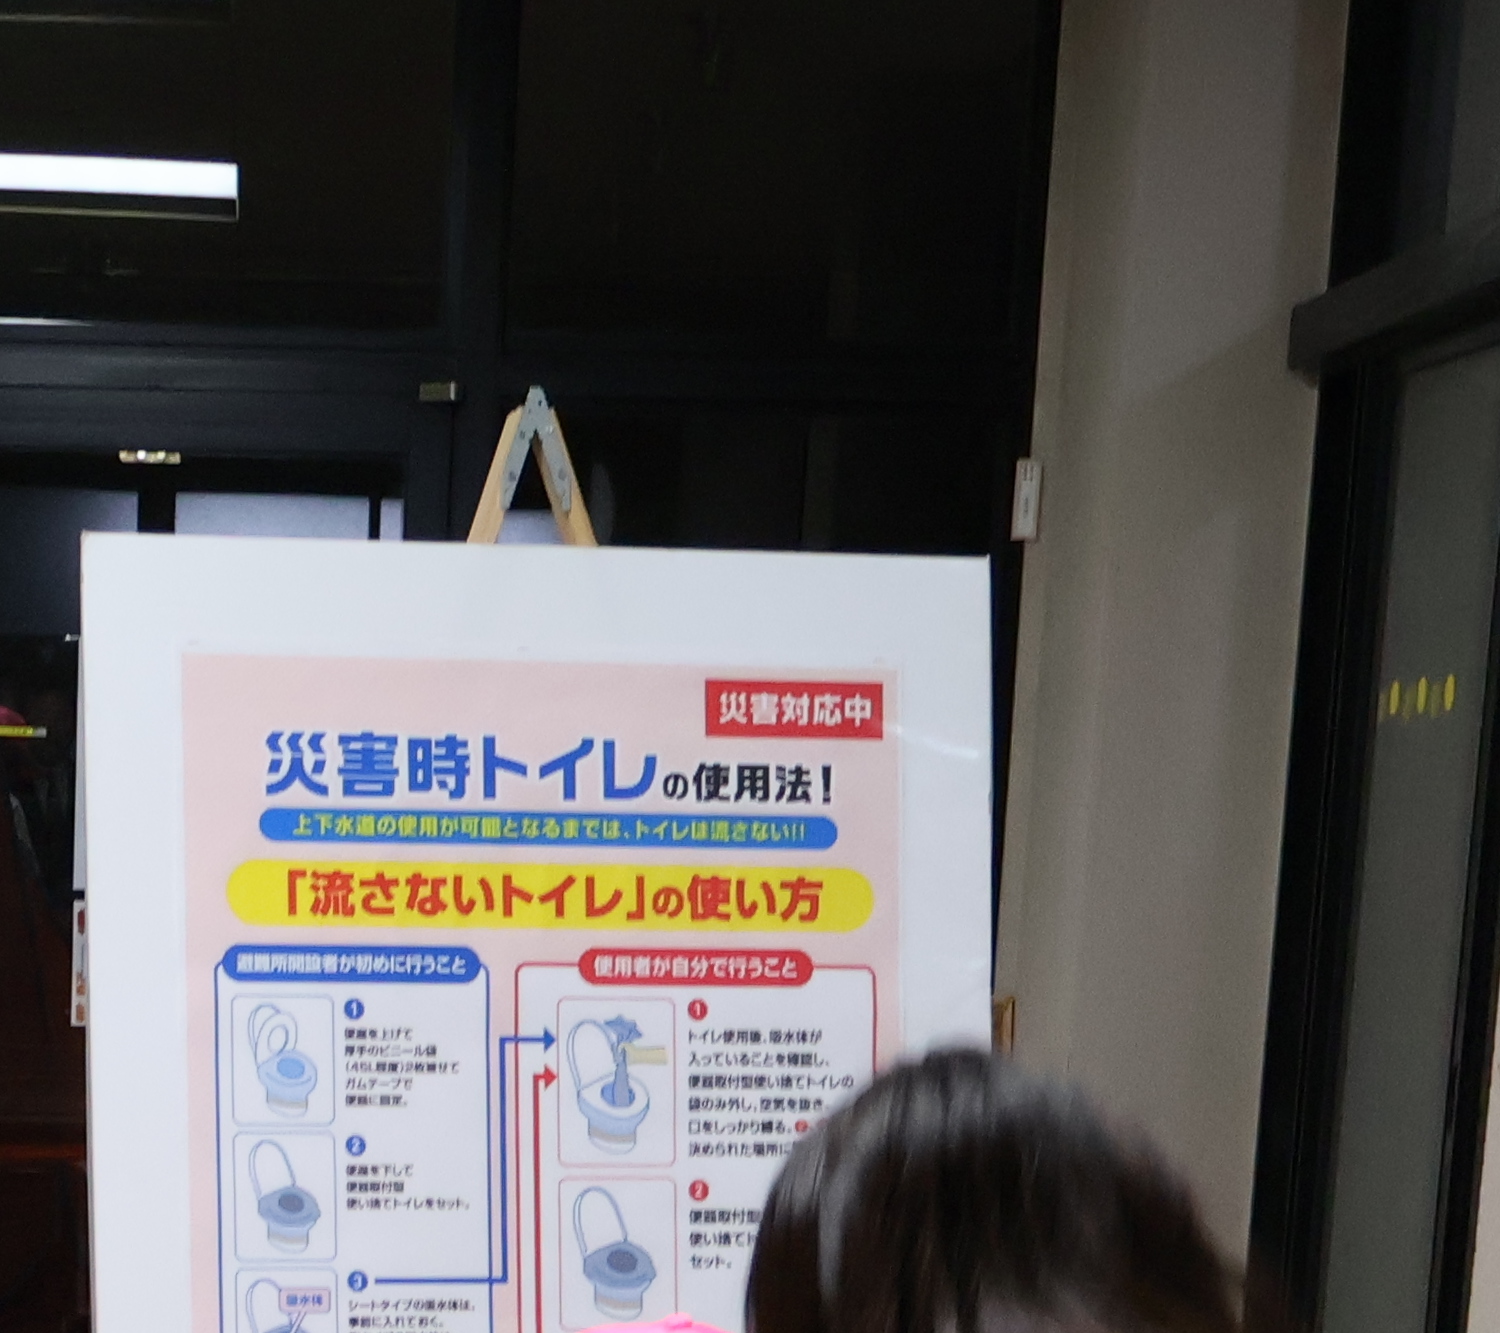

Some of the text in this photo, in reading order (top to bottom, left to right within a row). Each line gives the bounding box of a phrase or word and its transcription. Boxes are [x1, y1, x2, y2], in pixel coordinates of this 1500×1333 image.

[719, 690, 871, 728] 災害対応中
[265, 730, 832, 805] 災害時トイレの使用法!
[286, 868, 824, 923] 「流さないトイレ」の使い方
[594, 955, 798, 979] 使用者が自分で行うこと
